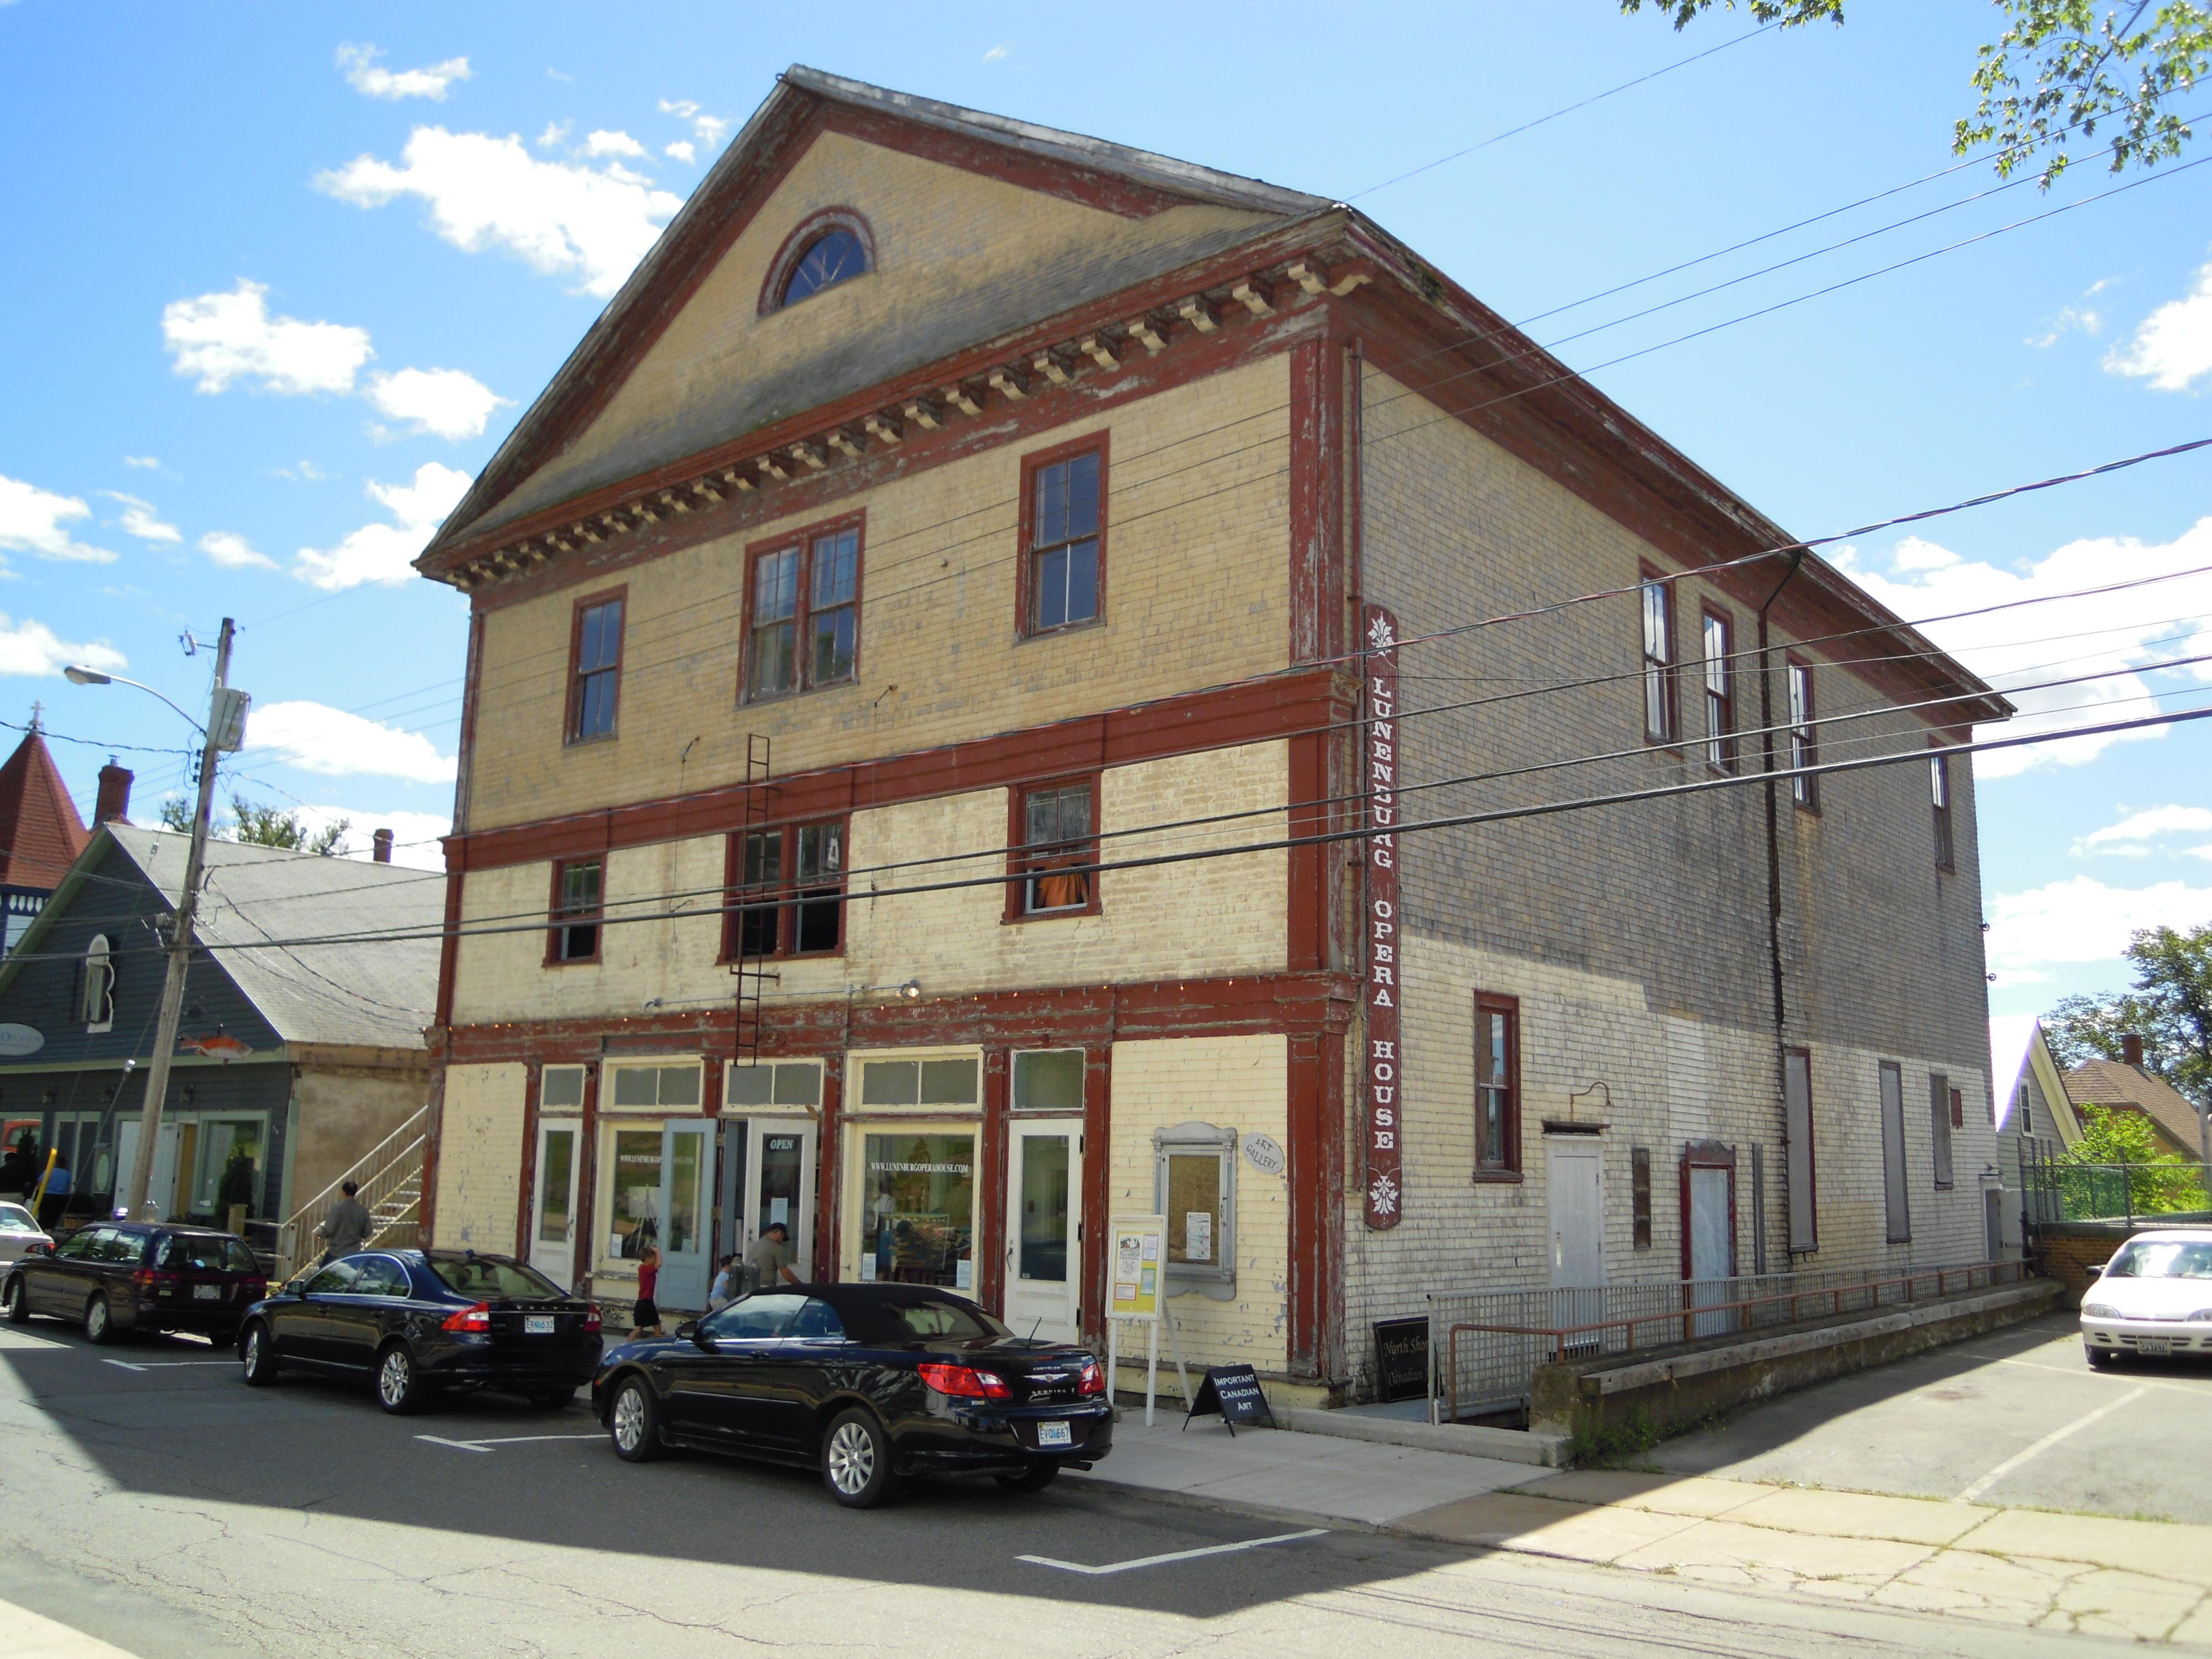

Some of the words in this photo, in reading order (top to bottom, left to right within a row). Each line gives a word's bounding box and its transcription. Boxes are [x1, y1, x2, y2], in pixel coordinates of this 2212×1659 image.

[1373, 677, 1393, 868] LUNENBURG
[1373, 900, 1394, 1007] OPERA
[1373, 1040, 1394, 1149] HOUSE
[770, 1139, 793, 1149] OPEN
[1256, 1139, 1274, 1151] ART
[1246, 1144, 1277, 1168] GALLERY
[871, 1162, 968, 1172] WWW.LUNENBURGOPERAHOUSE.COM
[1384, 1337, 1408, 1355] North
[1410, 1336, 1429, 1353] Shor
[1214, 1374, 1255, 1386] IMPORTANT
[1220, 1387, 1259, 1399] CANADIAN
[1238, 1402, 1252, 1411] ART
[1056, 1427, 1069, 1438] 667
